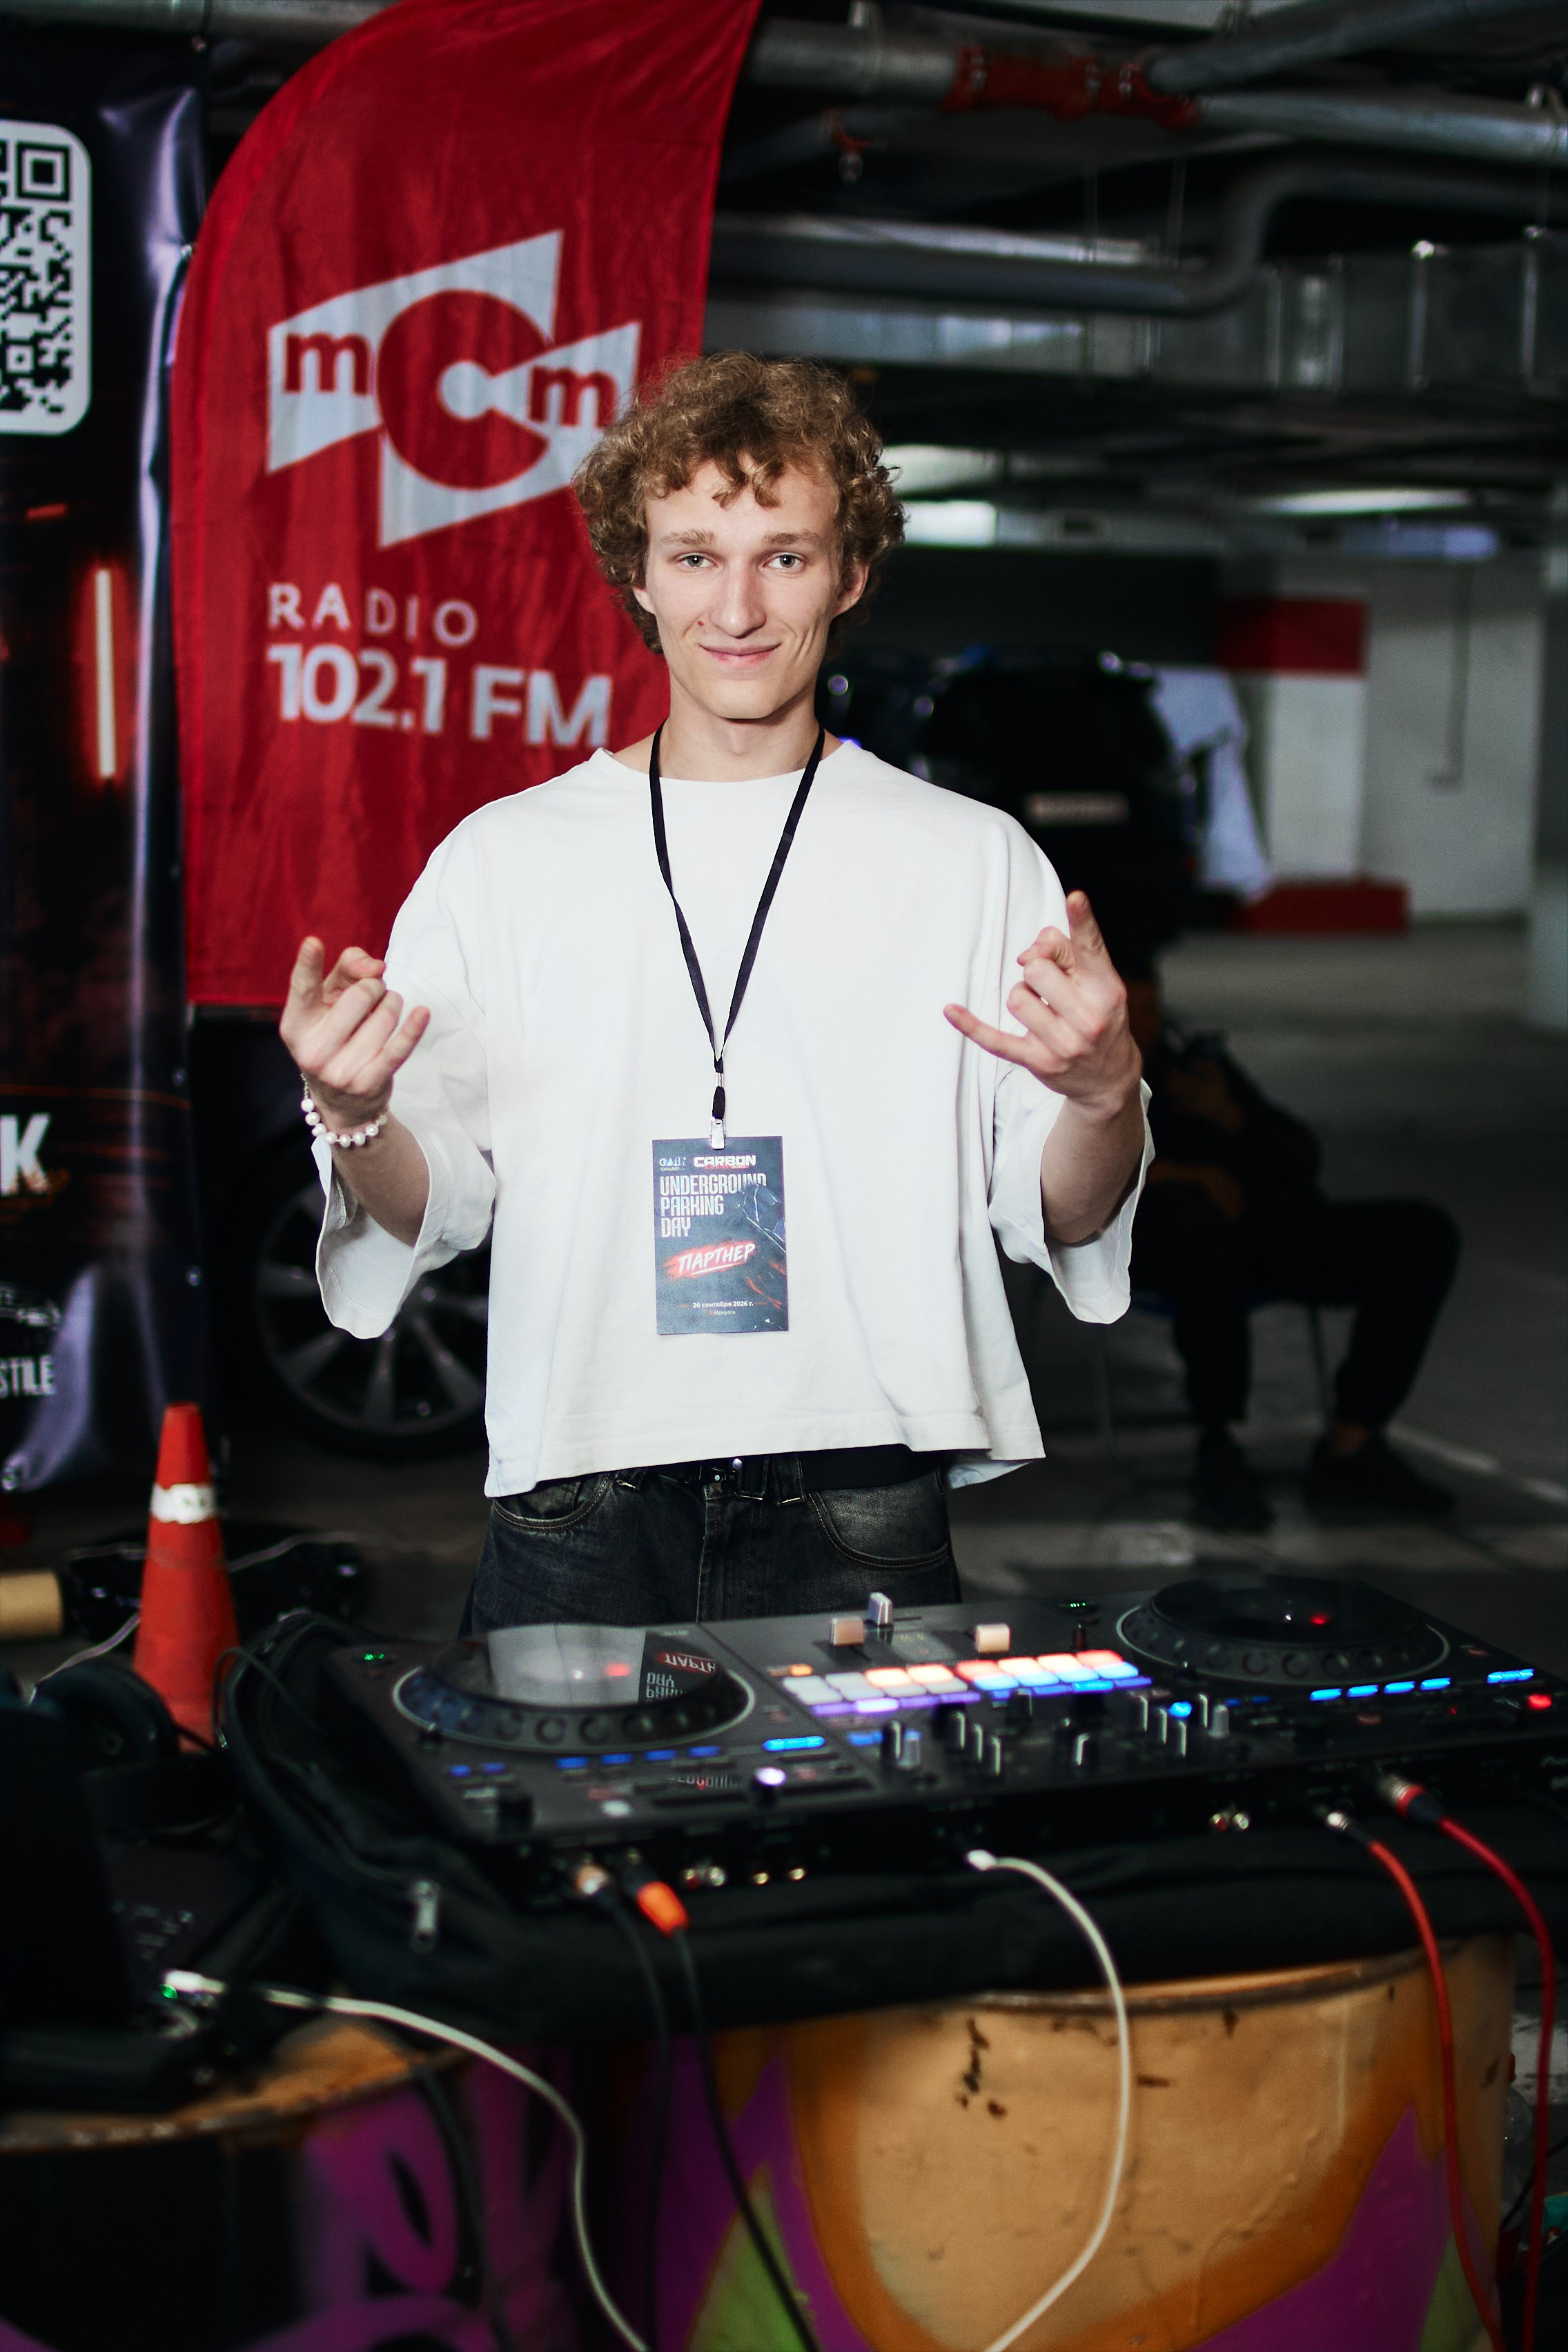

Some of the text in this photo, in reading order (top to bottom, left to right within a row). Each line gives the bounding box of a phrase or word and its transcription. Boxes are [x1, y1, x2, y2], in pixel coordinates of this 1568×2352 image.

[268, 583, 478, 647] RADIO
[268, 643, 612, 748] 102.1 FM
[694, 1155, 756, 1167] CARBON
[660, 1173, 767, 1196] UNDERGROUND
[660, 1195, 725, 1216] PARKING
[661, 1217, 691, 1237] DAY
[679, 1243, 756, 1274] ПАРТНЕР
